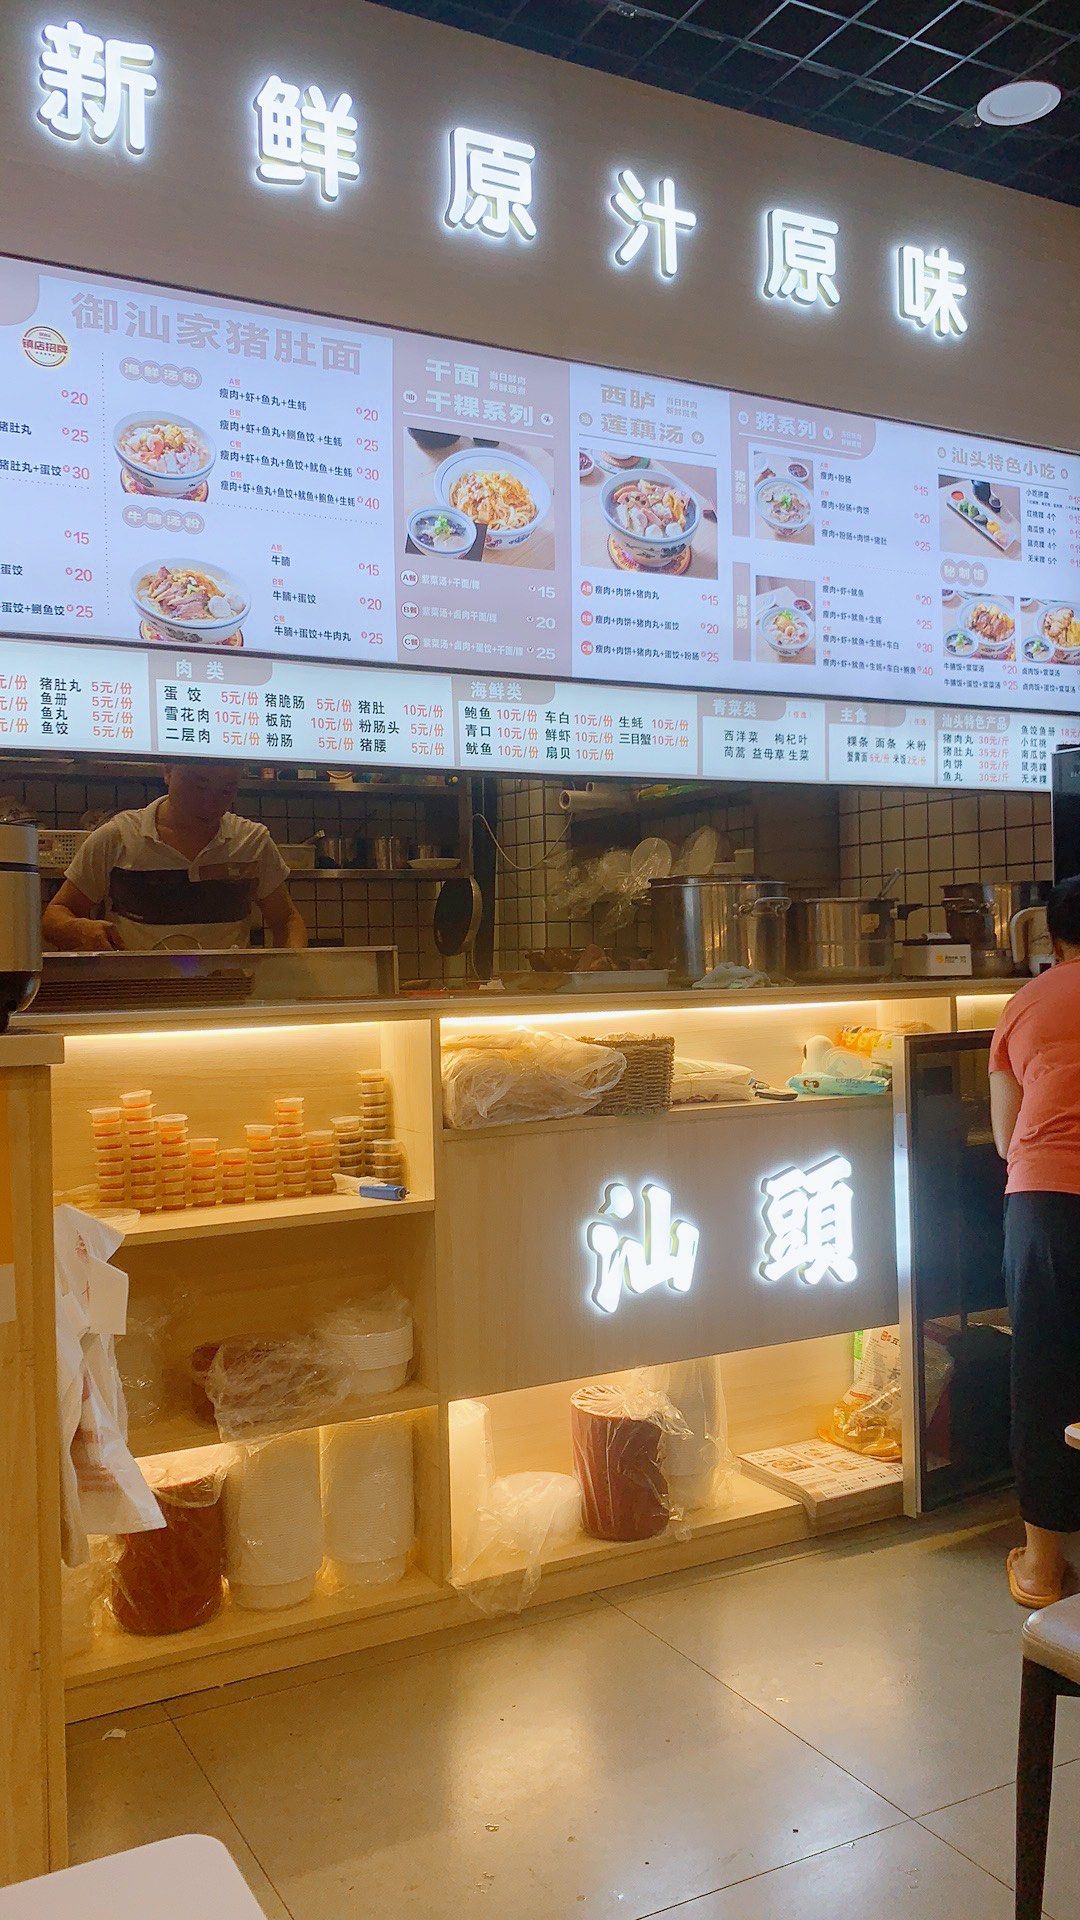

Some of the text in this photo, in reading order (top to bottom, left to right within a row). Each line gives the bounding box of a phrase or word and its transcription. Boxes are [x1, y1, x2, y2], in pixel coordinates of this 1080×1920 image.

[36, 20, 968, 338] 新鲜原汁原味
[71, 291, 362, 375] 御汕家猪肚面
[22, 338, 68, 355] 镇店招牌
[425, 358, 480, 388] 干面
[70, 392, 89, 405] 20
[219, 387, 307, 411] 瘦肉+虾+鱼丸+生蚝
[363, 408, 379, 422] 20
[600, 412, 684, 444] 莲藕汤
[755, 411, 817, 440] 粥系列
[70, 428, 89, 443] 25
[363, 438, 379, 452] 25
[220, 450, 353, 478] 瘦肉+虾+鱼丸+鱼饺+鱿鱼+生蚝
[951, 446, 1056, 480] 汕头特色小吃
[72, 466, 90, 480] 30
[364, 467, 379, 481] 30
[364, 497, 380, 510] 40
[920, 513, 930, 525] 20
[73, 531, 90, 545] 15
[271, 555, 291, 567] 牛腩
[74, 568, 93, 582] 20
[365, 564, 380, 576] 15
[272, 590, 316, 605] 牛腩+蛋饺
[538, 586, 556, 599] 15
[595, 585, 660, 601] 瘦肉+肉饼+猪肉丸
[367, 598, 382, 611] 20
[707, 596, 719, 606] 15
[921, 595, 932, 606] 20
[75, 605, 94, 618] 25
[536, 617, 556, 630] 20
[706, 624, 719, 635] 20
[921, 619, 933, 631] 25
[274, 626, 351, 642] 牛腩+蛋饺+牛肉丸
[368, 632, 383, 645] 25
[536, 647, 556, 660] 25
[706, 652, 719, 663] 25
[175, 659, 225, 681] 肉类
[922, 666, 934, 677] 40
[1007, 665, 1018, 675] 20
[40, 677, 82, 693] 猪肚丸
[91, 681, 132, 695] 5元/份
[470, 680, 523, 700] 海鲜类
[1007, 681, 1018, 691] 25
[41, 691, 68, 706] 鱼册
[92, 696, 133, 710] 5元/份
[164, 685, 444, 719] 蛋饺 5元/份 猪脆肠 5元/份 猪肚 10元/份
[41, 706, 68, 720] 鱼丸
[92, 711, 133, 724] 5元/份
[712, 698, 758, 718] 青菜类
[840, 707, 868, 723] 主食
[164, 705, 444, 737] 雪花肉 10元/份 板筋 10元/份 粉肠头 5元/份
[464, 706, 689, 732] 鲍鱼 10元/份 车白 10元/份 生蚝 10元/份
[941, 713, 1008, 731] 汕头特色产品
[41, 721, 134, 739] 鱼饺 5元/份
[465, 724, 689, 748] 青口 10元/份 鲜虾 10元/份 三目蟹 10元/份
[165, 727, 445, 756] 二层肉 5元/份 粉肠 5元/份 猪腰 5元/份
[724, 729, 808, 746] 西洋菜 枸杞叶
[875, 737, 897, 750] 面条
[905, 739, 927, 751] 米粉
[943, 733, 974, 745] 猪肉丸
[979, 736, 1009, 746] 30元/斤
[465, 742, 614, 761] 鱿鱼 10元/份 扇贝 10元/份
[752, 748, 785, 761] 益母草
[788, 749, 809, 761] 生菜
[943, 746, 974, 758] 猪肚丸
[943, 759, 963, 770] 肉饼
[943, 771, 963, 782] 鱼丸
[587, 1155, 858, 1313] 汕頭
